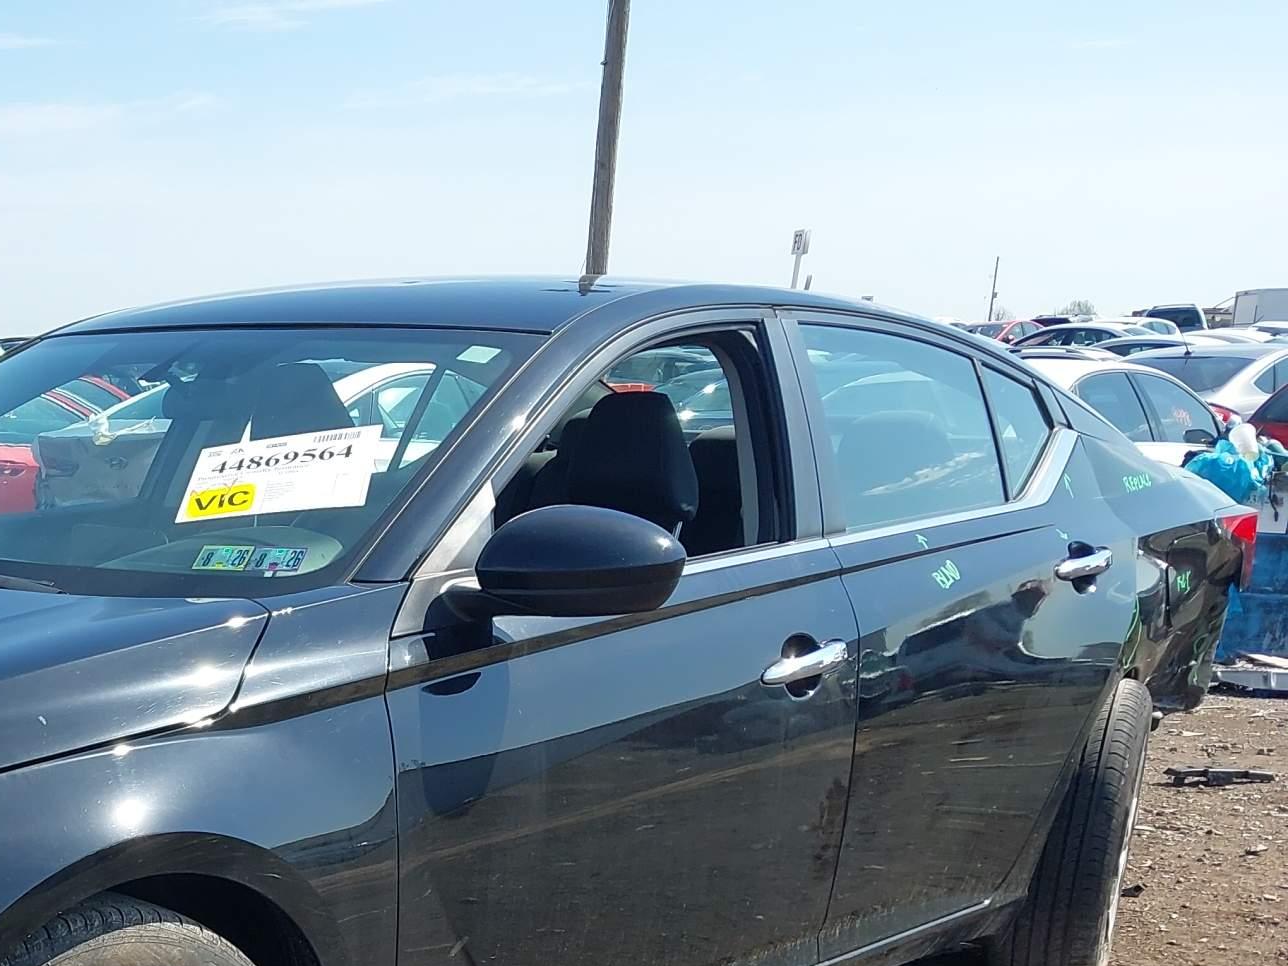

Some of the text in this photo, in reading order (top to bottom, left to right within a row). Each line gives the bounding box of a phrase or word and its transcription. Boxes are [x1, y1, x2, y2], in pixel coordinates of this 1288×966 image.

[212, 444, 353, 474] 44869564
[231, 549, 249, 567] 26
[285, 550, 304, 567] 26
